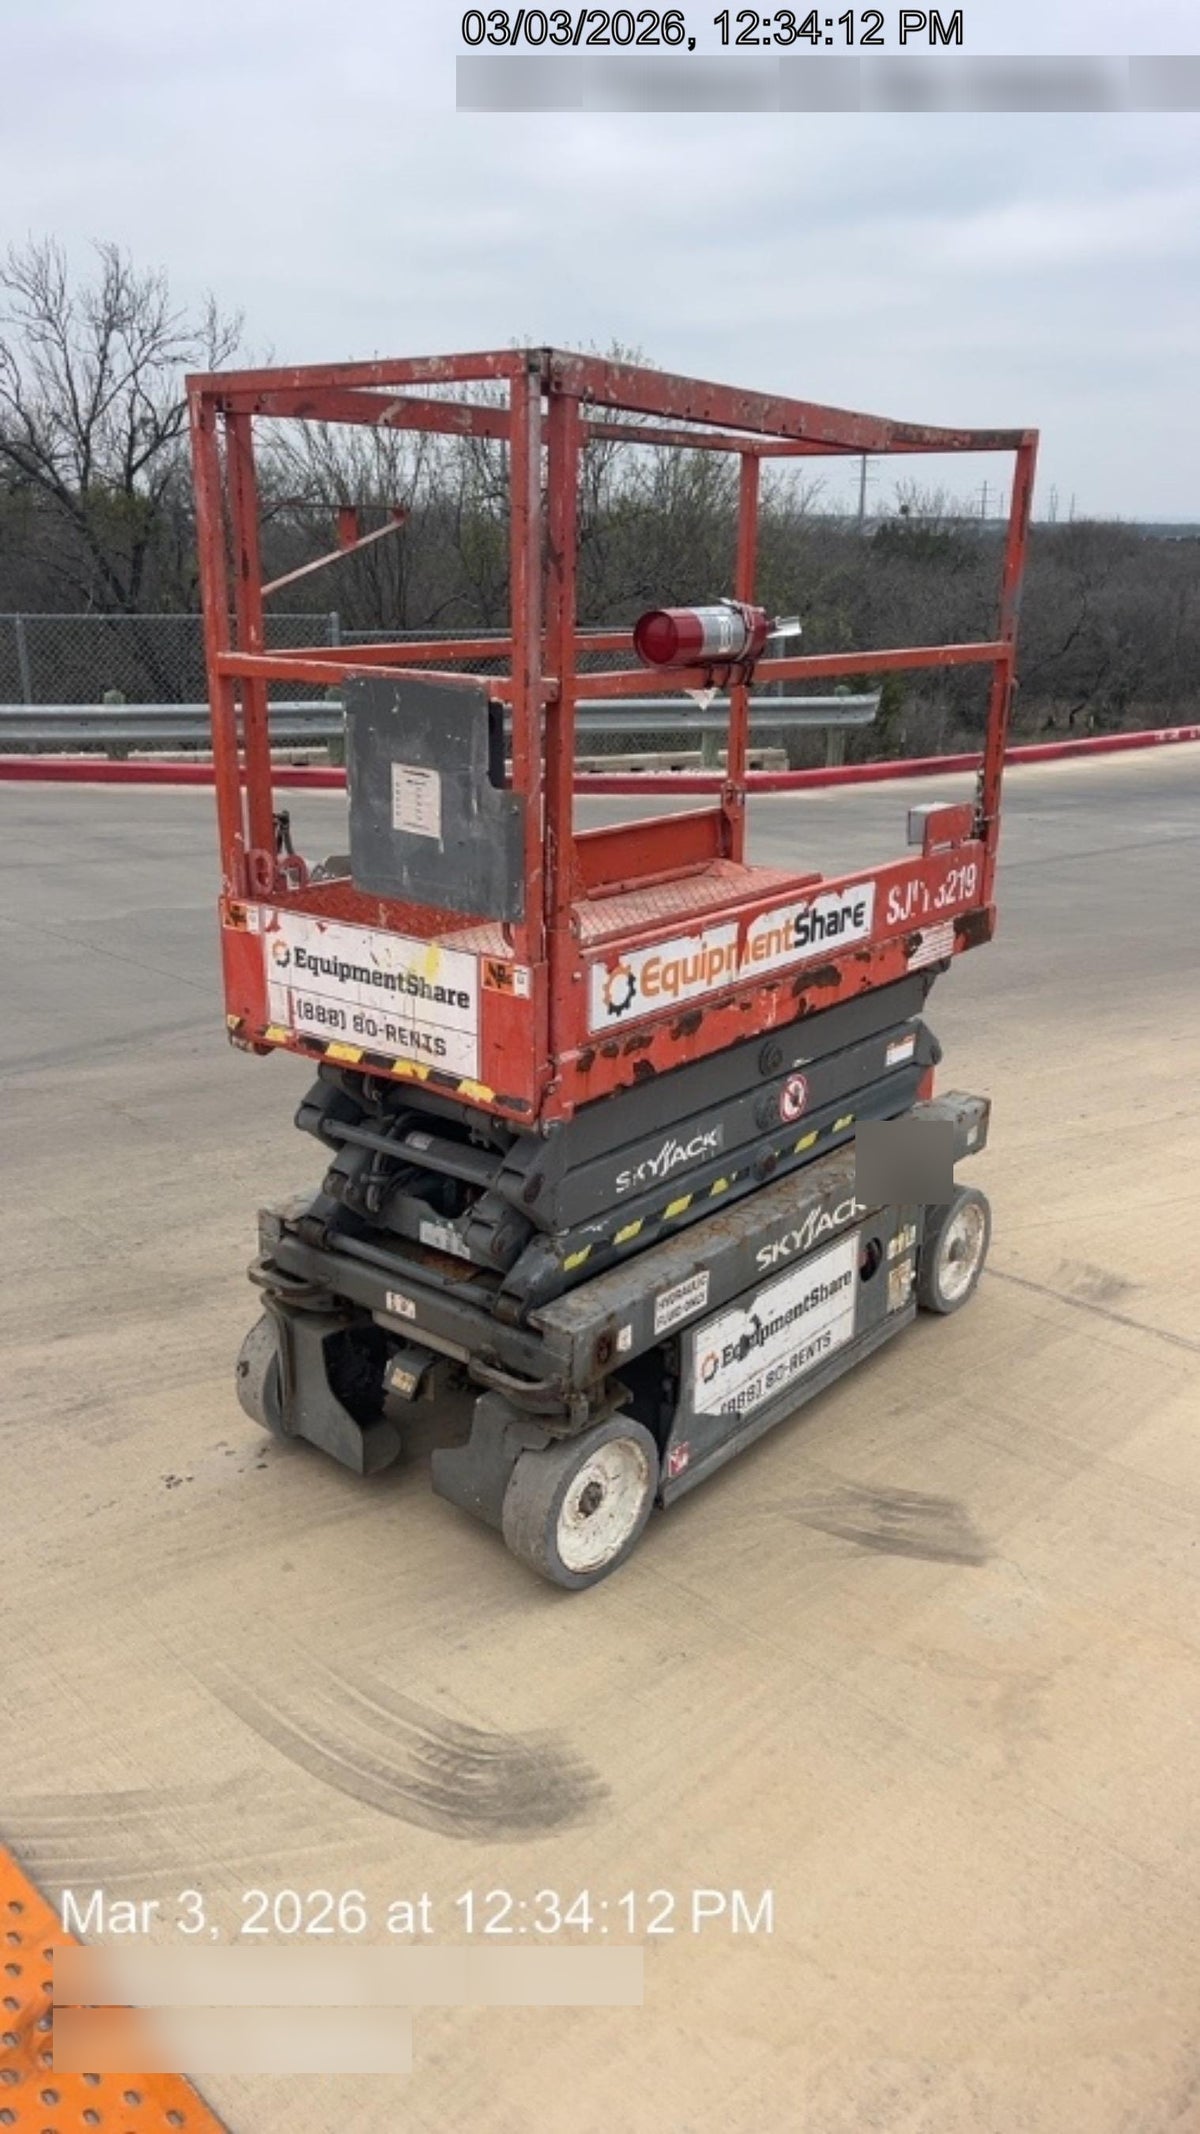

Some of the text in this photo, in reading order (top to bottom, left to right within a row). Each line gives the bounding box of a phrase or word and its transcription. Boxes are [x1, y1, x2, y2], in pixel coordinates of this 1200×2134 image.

[293, 946, 471, 1010] EquipmentShare
[296, 998, 448, 1057] (888) 80-RENTS
